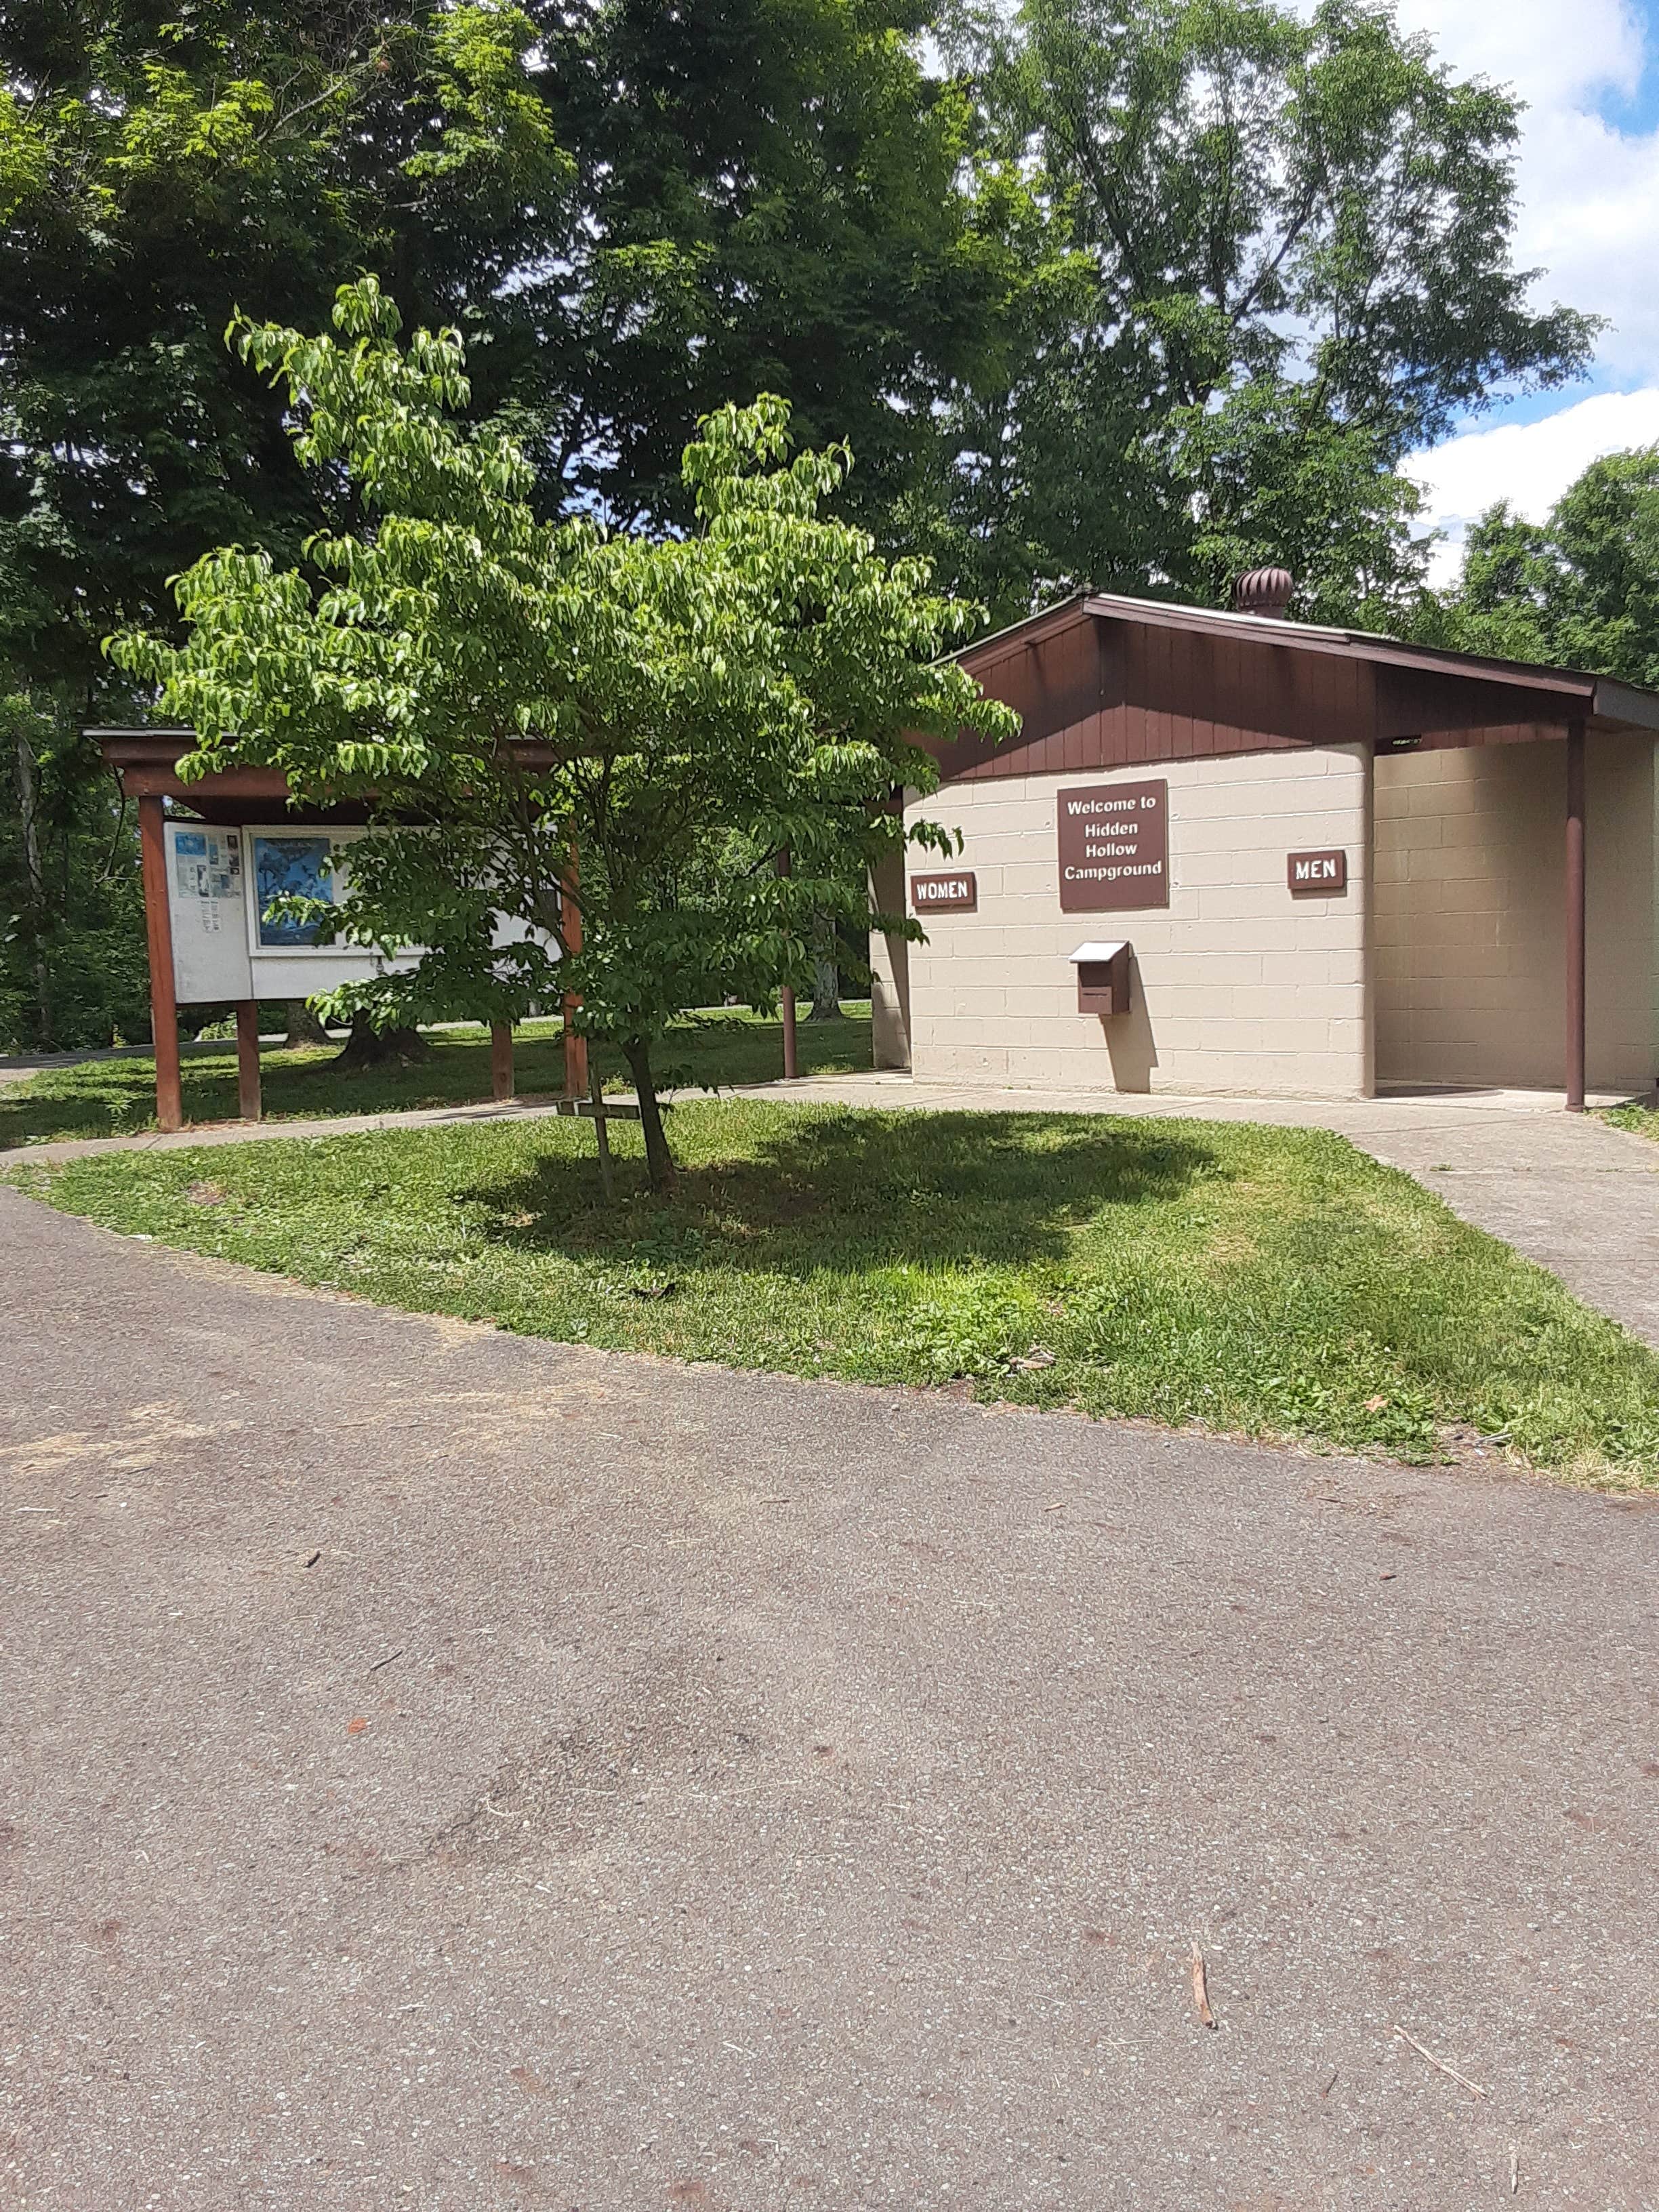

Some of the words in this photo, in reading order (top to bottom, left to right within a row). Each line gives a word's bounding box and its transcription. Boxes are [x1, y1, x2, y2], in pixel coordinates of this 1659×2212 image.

[1067, 798, 1136, 815] Welcome
[1141, 796, 1156, 809] to
[1085, 822, 1139, 838] Hidden
[1086, 842, 1138, 857] Hollow
[1065, 861, 1162, 881] Campground
[1296, 859, 1336, 880] MEN
[916, 880, 968, 900] WOMEN
